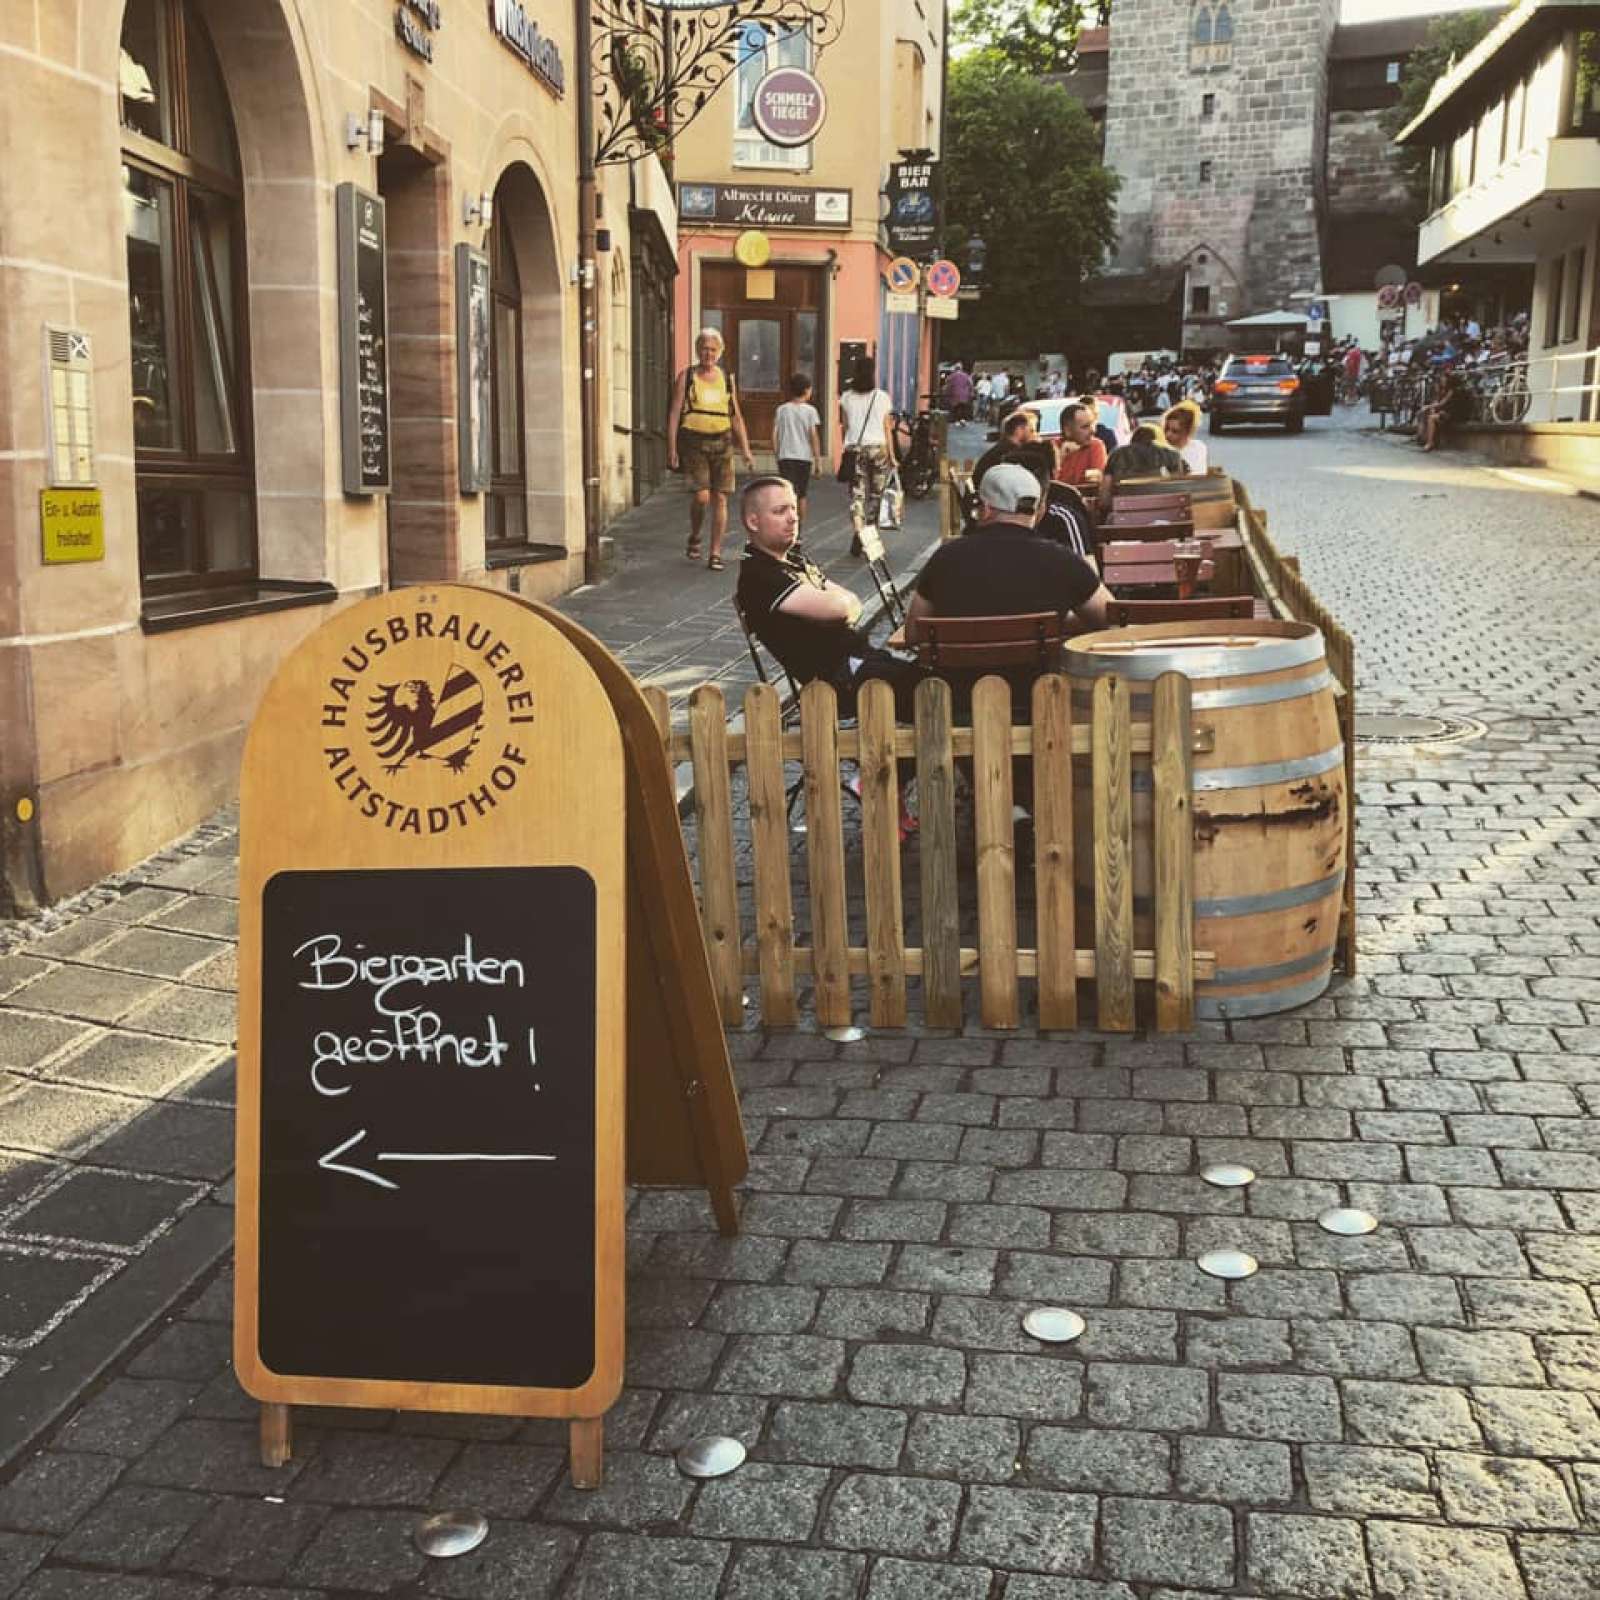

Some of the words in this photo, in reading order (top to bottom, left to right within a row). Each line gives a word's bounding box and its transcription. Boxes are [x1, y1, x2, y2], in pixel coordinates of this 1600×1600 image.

[765, 92, 816, 106] SCHMELZ
[770, 106, 809, 120] TIEGEL
[898, 166, 931, 177] BIER
[901, 177, 929, 188] BAR
[721, 188, 773, 202] Albrecht
[321, 612, 535, 727] HAUSBRAUEREI
[324, 743, 527, 835] ALTSTADTHOF
[293, 932, 525, 1016] Biergarten
